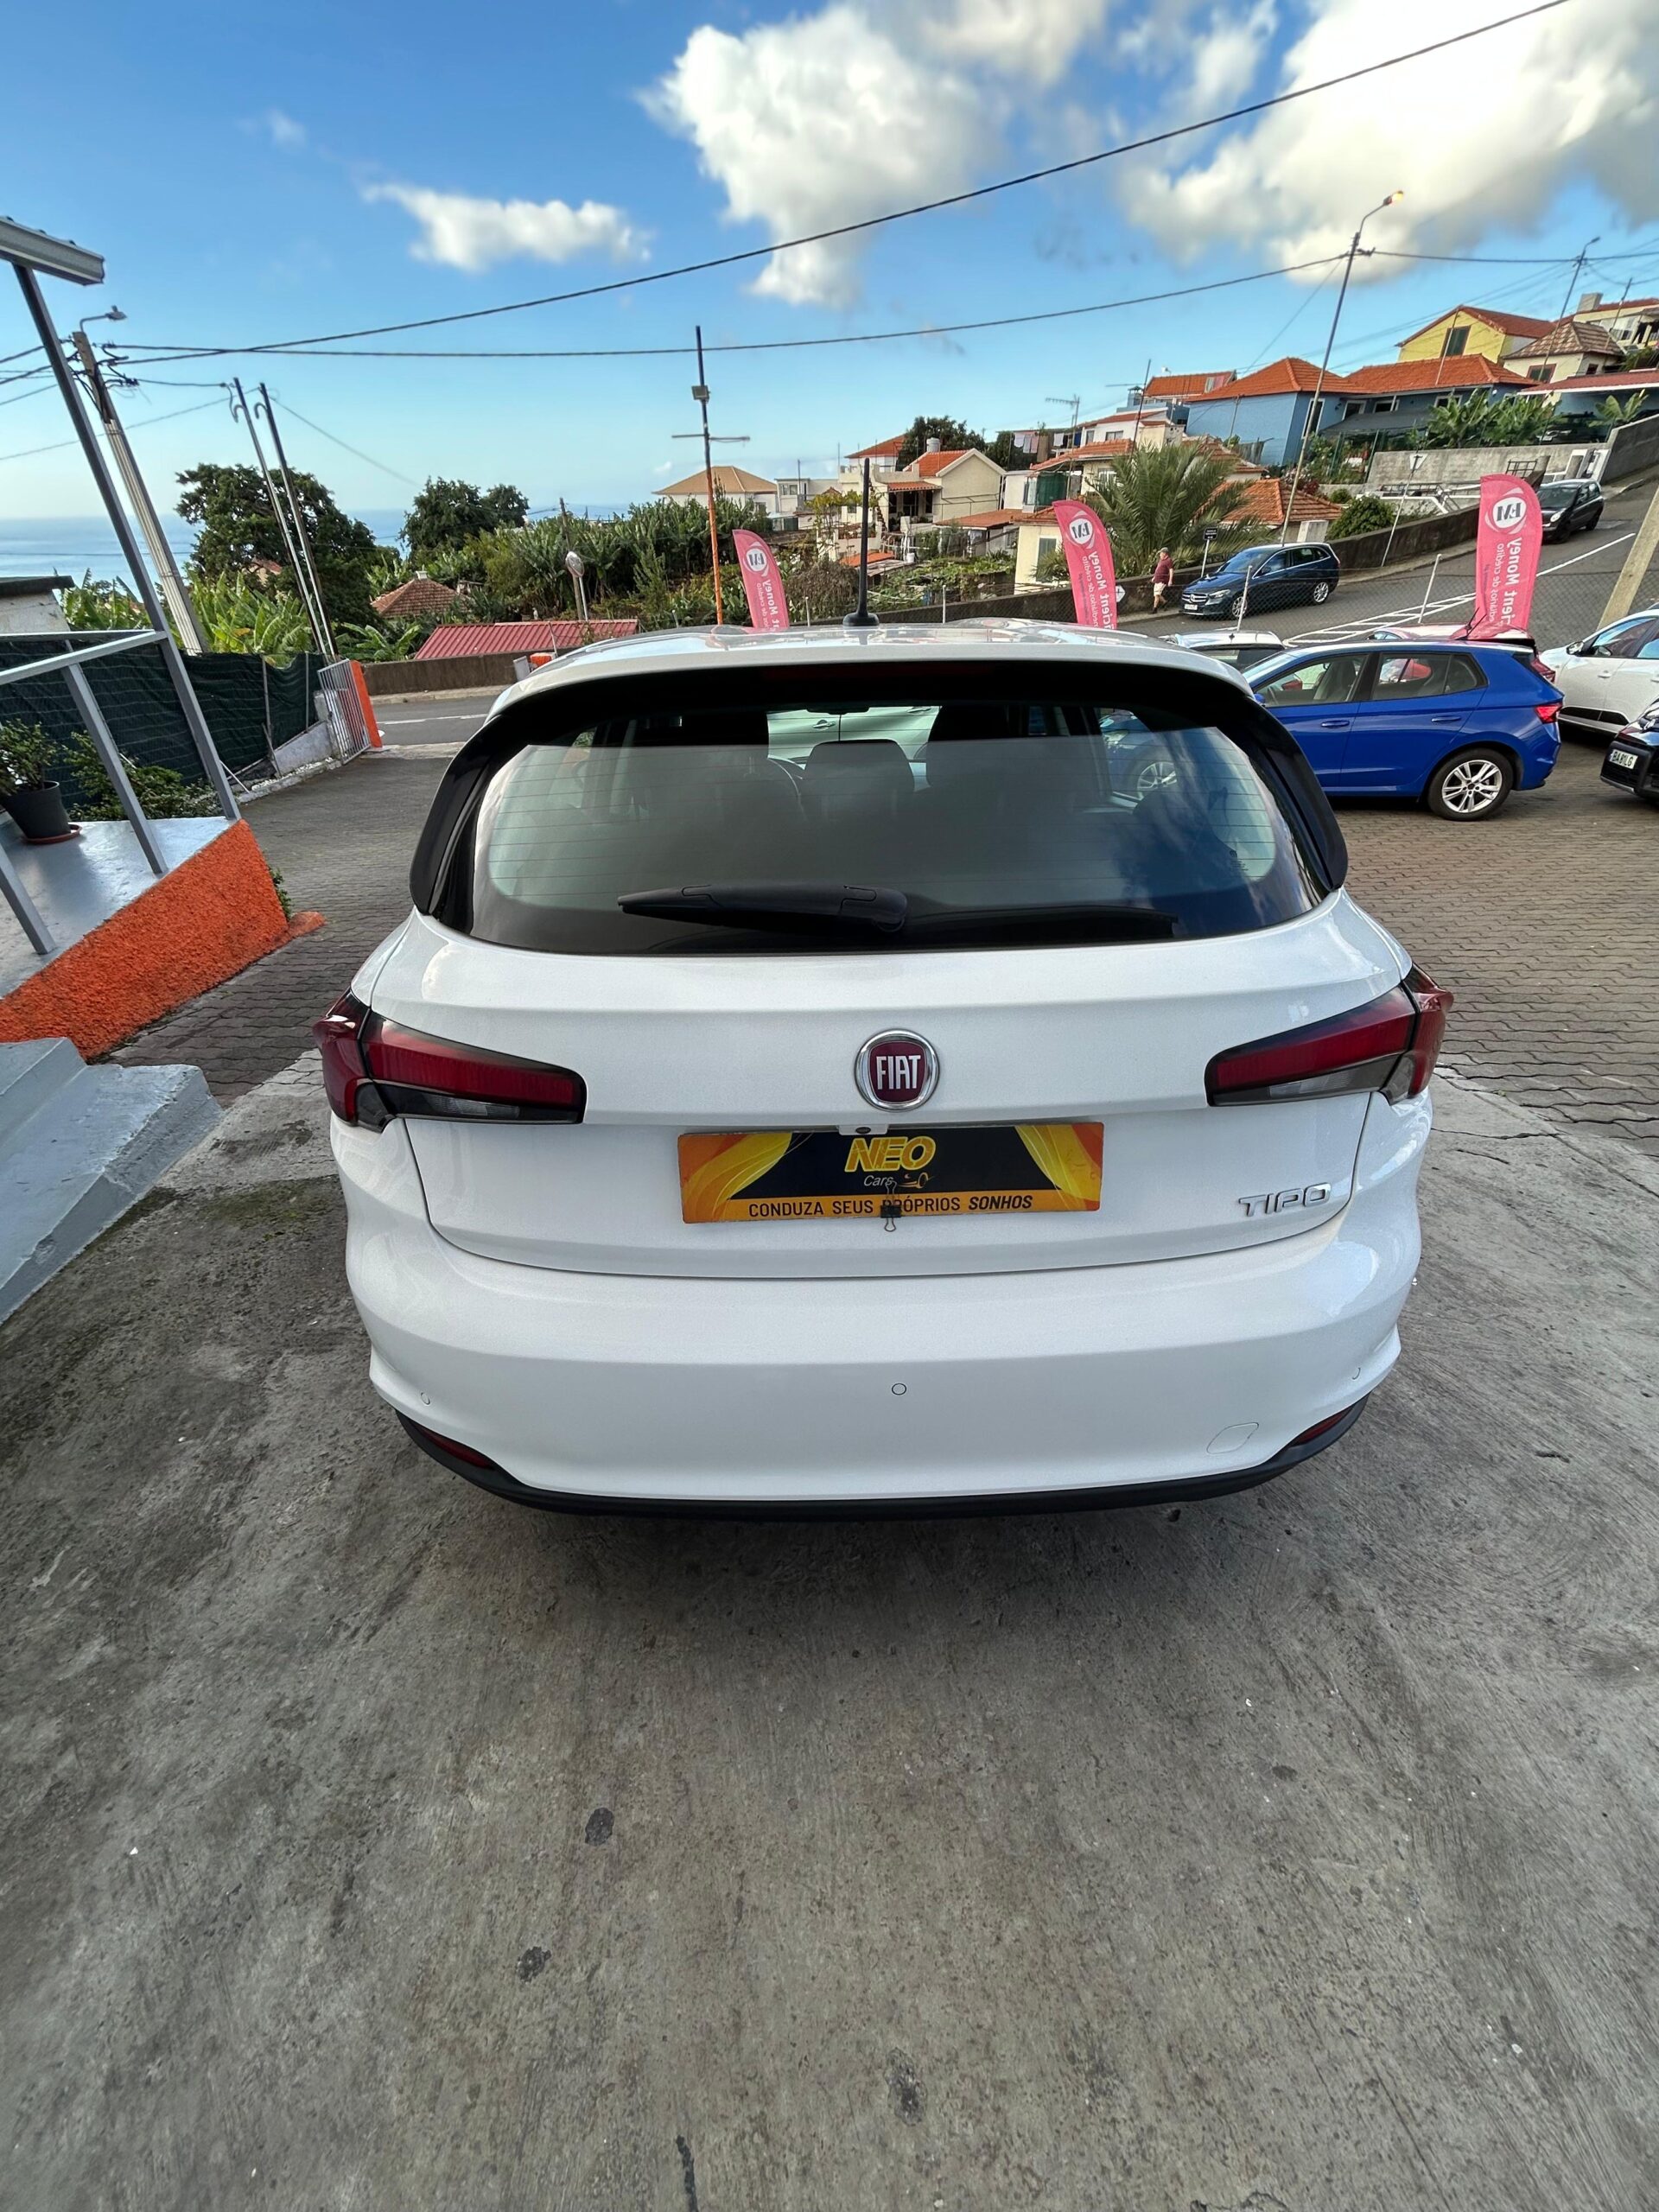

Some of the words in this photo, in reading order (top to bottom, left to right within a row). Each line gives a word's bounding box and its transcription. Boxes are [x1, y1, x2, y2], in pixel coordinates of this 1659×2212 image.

[875, 1055, 921, 1090] FIAT
[844, 1135, 937, 1173] NEO
[864, 1174, 894, 1186] Cars
[748, 1201, 824, 1217] CONDUZA
[832, 1199, 874, 1215] SEUS
[969, 1195, 1033, 1211] SONHOS
[1238, 1182, 1332, 1217] TIPO
